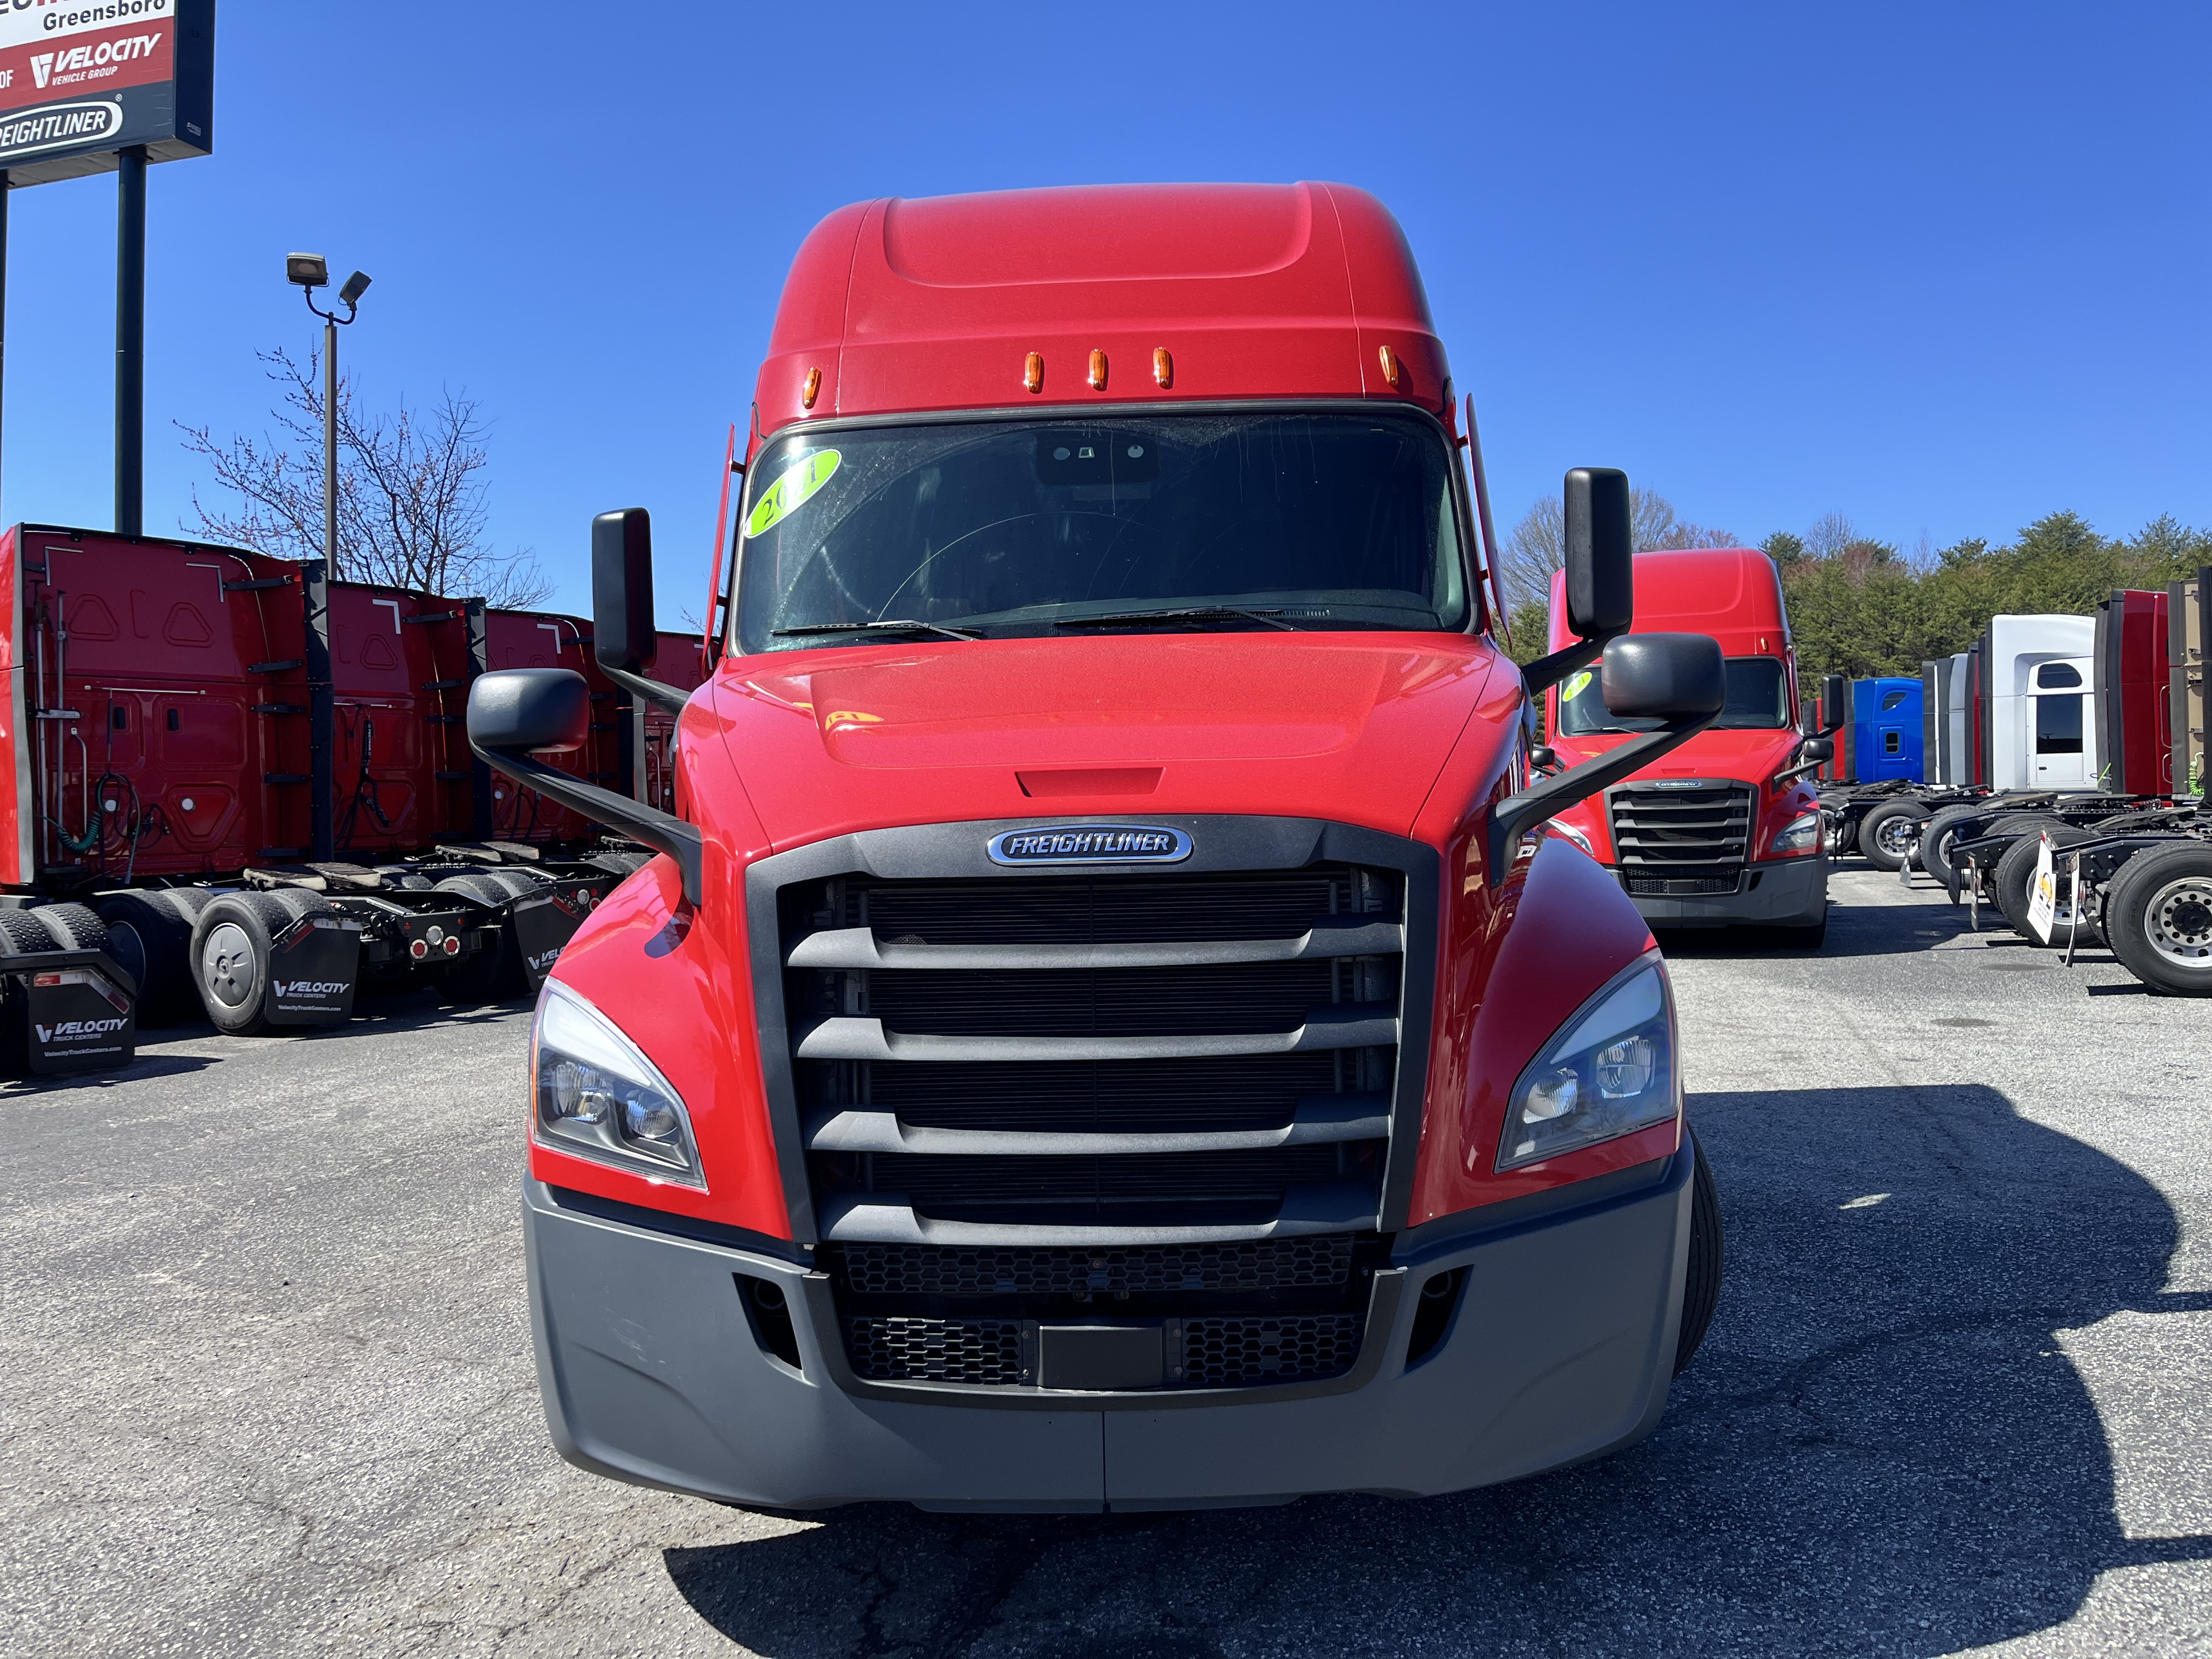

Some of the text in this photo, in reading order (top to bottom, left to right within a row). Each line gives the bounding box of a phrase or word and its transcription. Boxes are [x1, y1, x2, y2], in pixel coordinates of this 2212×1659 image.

[43, 0, 165, 31] Greensboro
[54, 33, 162, 72] VELOCITY
[52, 66, 118, 86] VEHICLE GROUP
[0, 110, 106, 147] EIGHTLINER
[1009, 832, 1170, 854] FREIGHTLINER
[289, 981, 350, 994] VELOCITY
[55, 1018, 128, 1035] VELOCITY
[44, 1046, 122, 1057] VelocityTruckCenters.com
